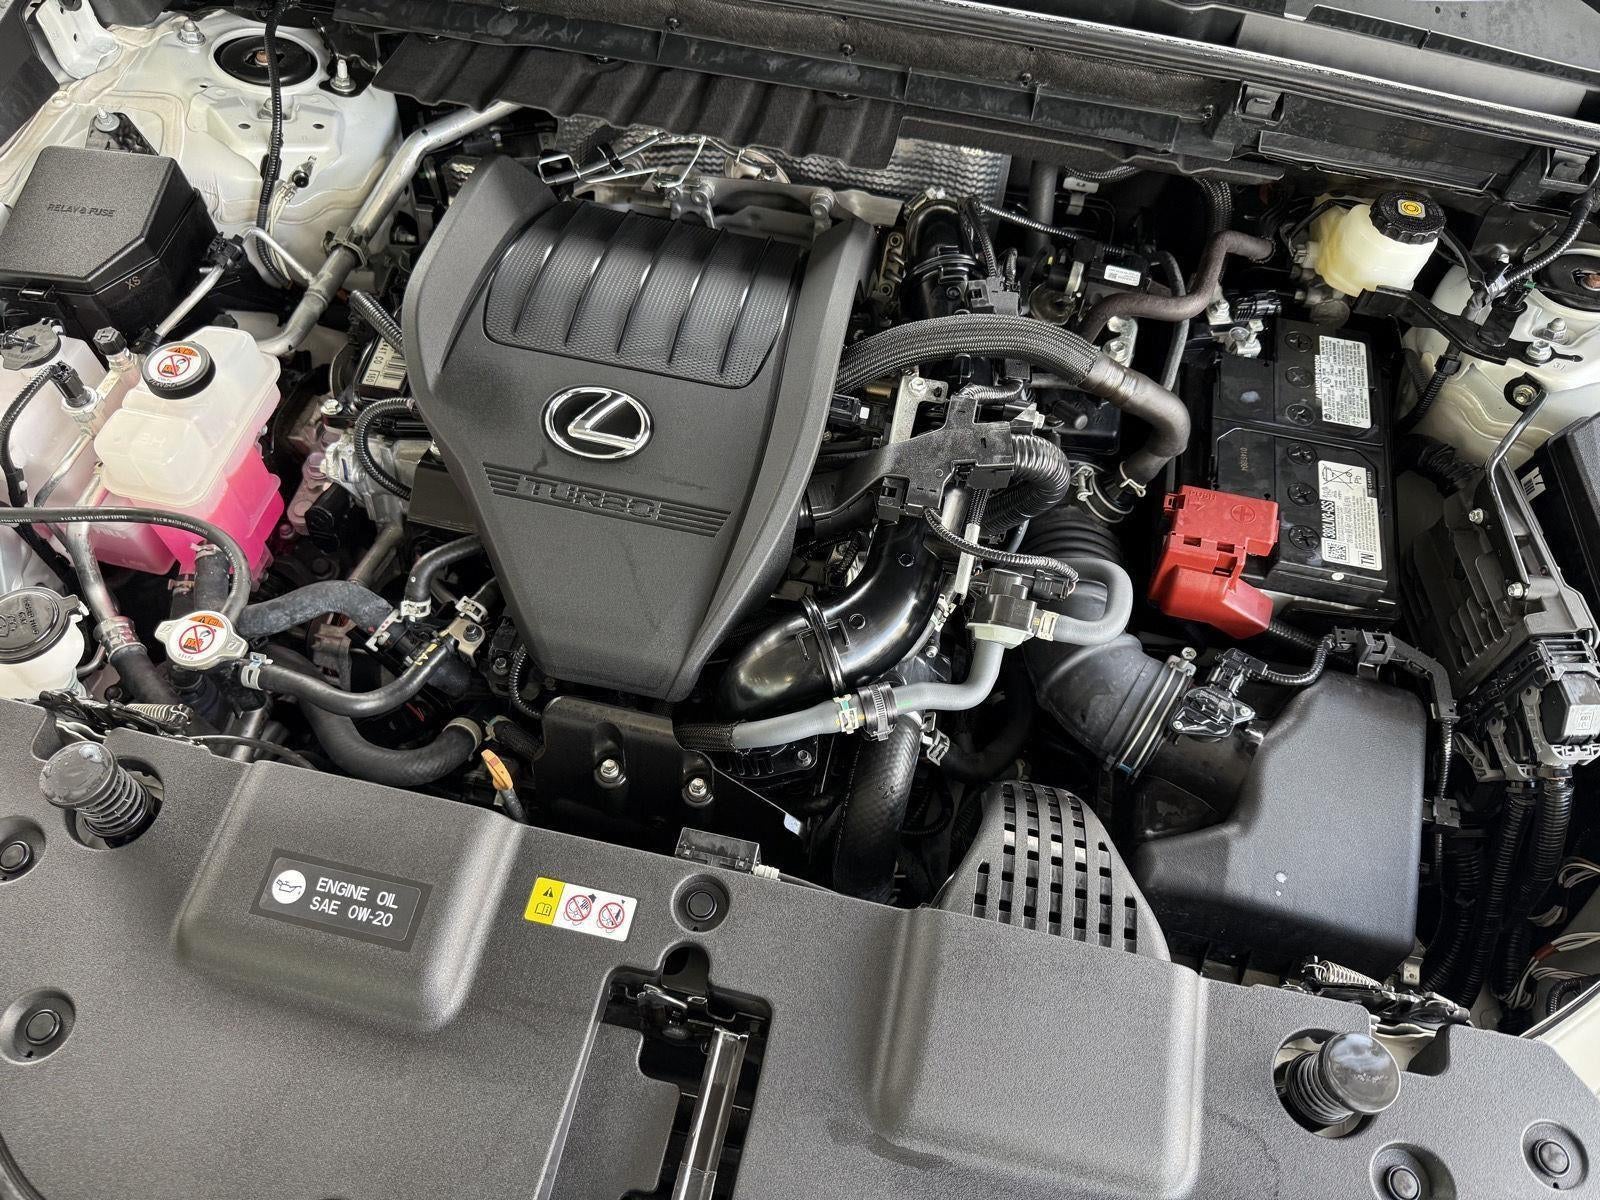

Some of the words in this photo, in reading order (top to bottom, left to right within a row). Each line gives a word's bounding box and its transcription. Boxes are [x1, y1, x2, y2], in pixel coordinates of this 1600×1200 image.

[518, 476, 654, 518] TURBO
[316, 877, 370, 901] ENGINE
[376, 891, 399, 909] OIL
[309, 896, 341, 915] SAE
[348, 905, 394, 927] 0W-20
